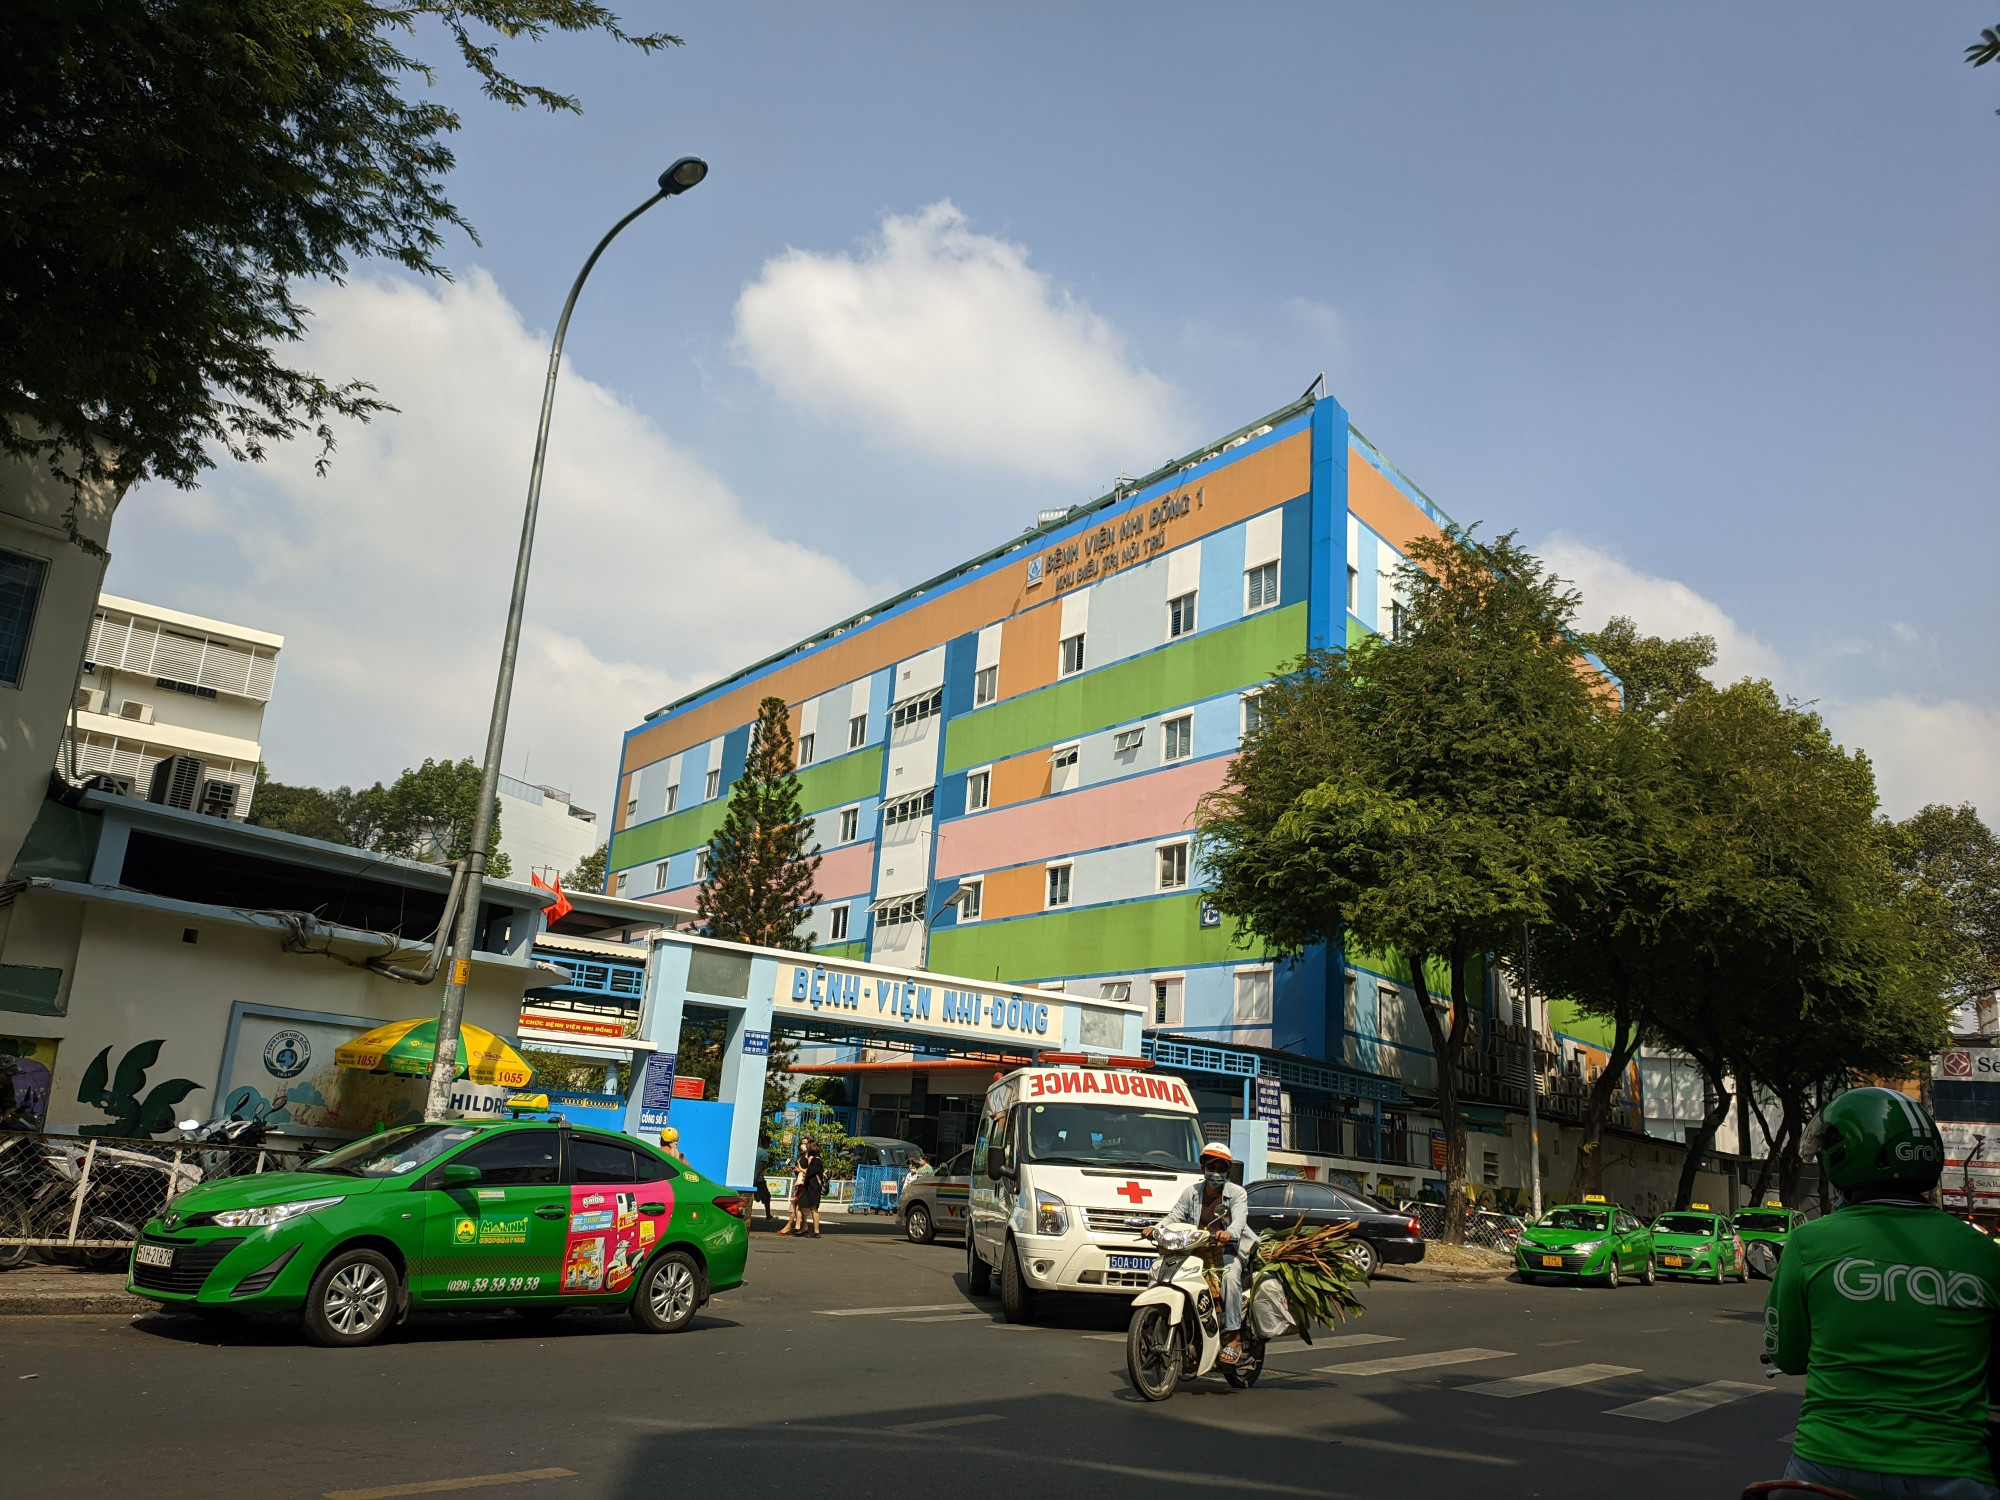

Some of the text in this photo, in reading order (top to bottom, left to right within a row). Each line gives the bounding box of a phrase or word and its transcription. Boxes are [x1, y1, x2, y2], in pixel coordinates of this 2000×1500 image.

[1046, 486, 1205, 575] BỆNH VIỆN NHI ĐỒNG 1
[1056, 568, 1075, 591] KHU
[357, 1055, 377, 1067] 1055
[1978, 1056, 2000, 1073] Se
[498, 1071, 523, 1084] 1055
[447, 1276, 541, 1293] (028) 38 38 38 38
[1833, 1257, 1988, 1309] Grab
